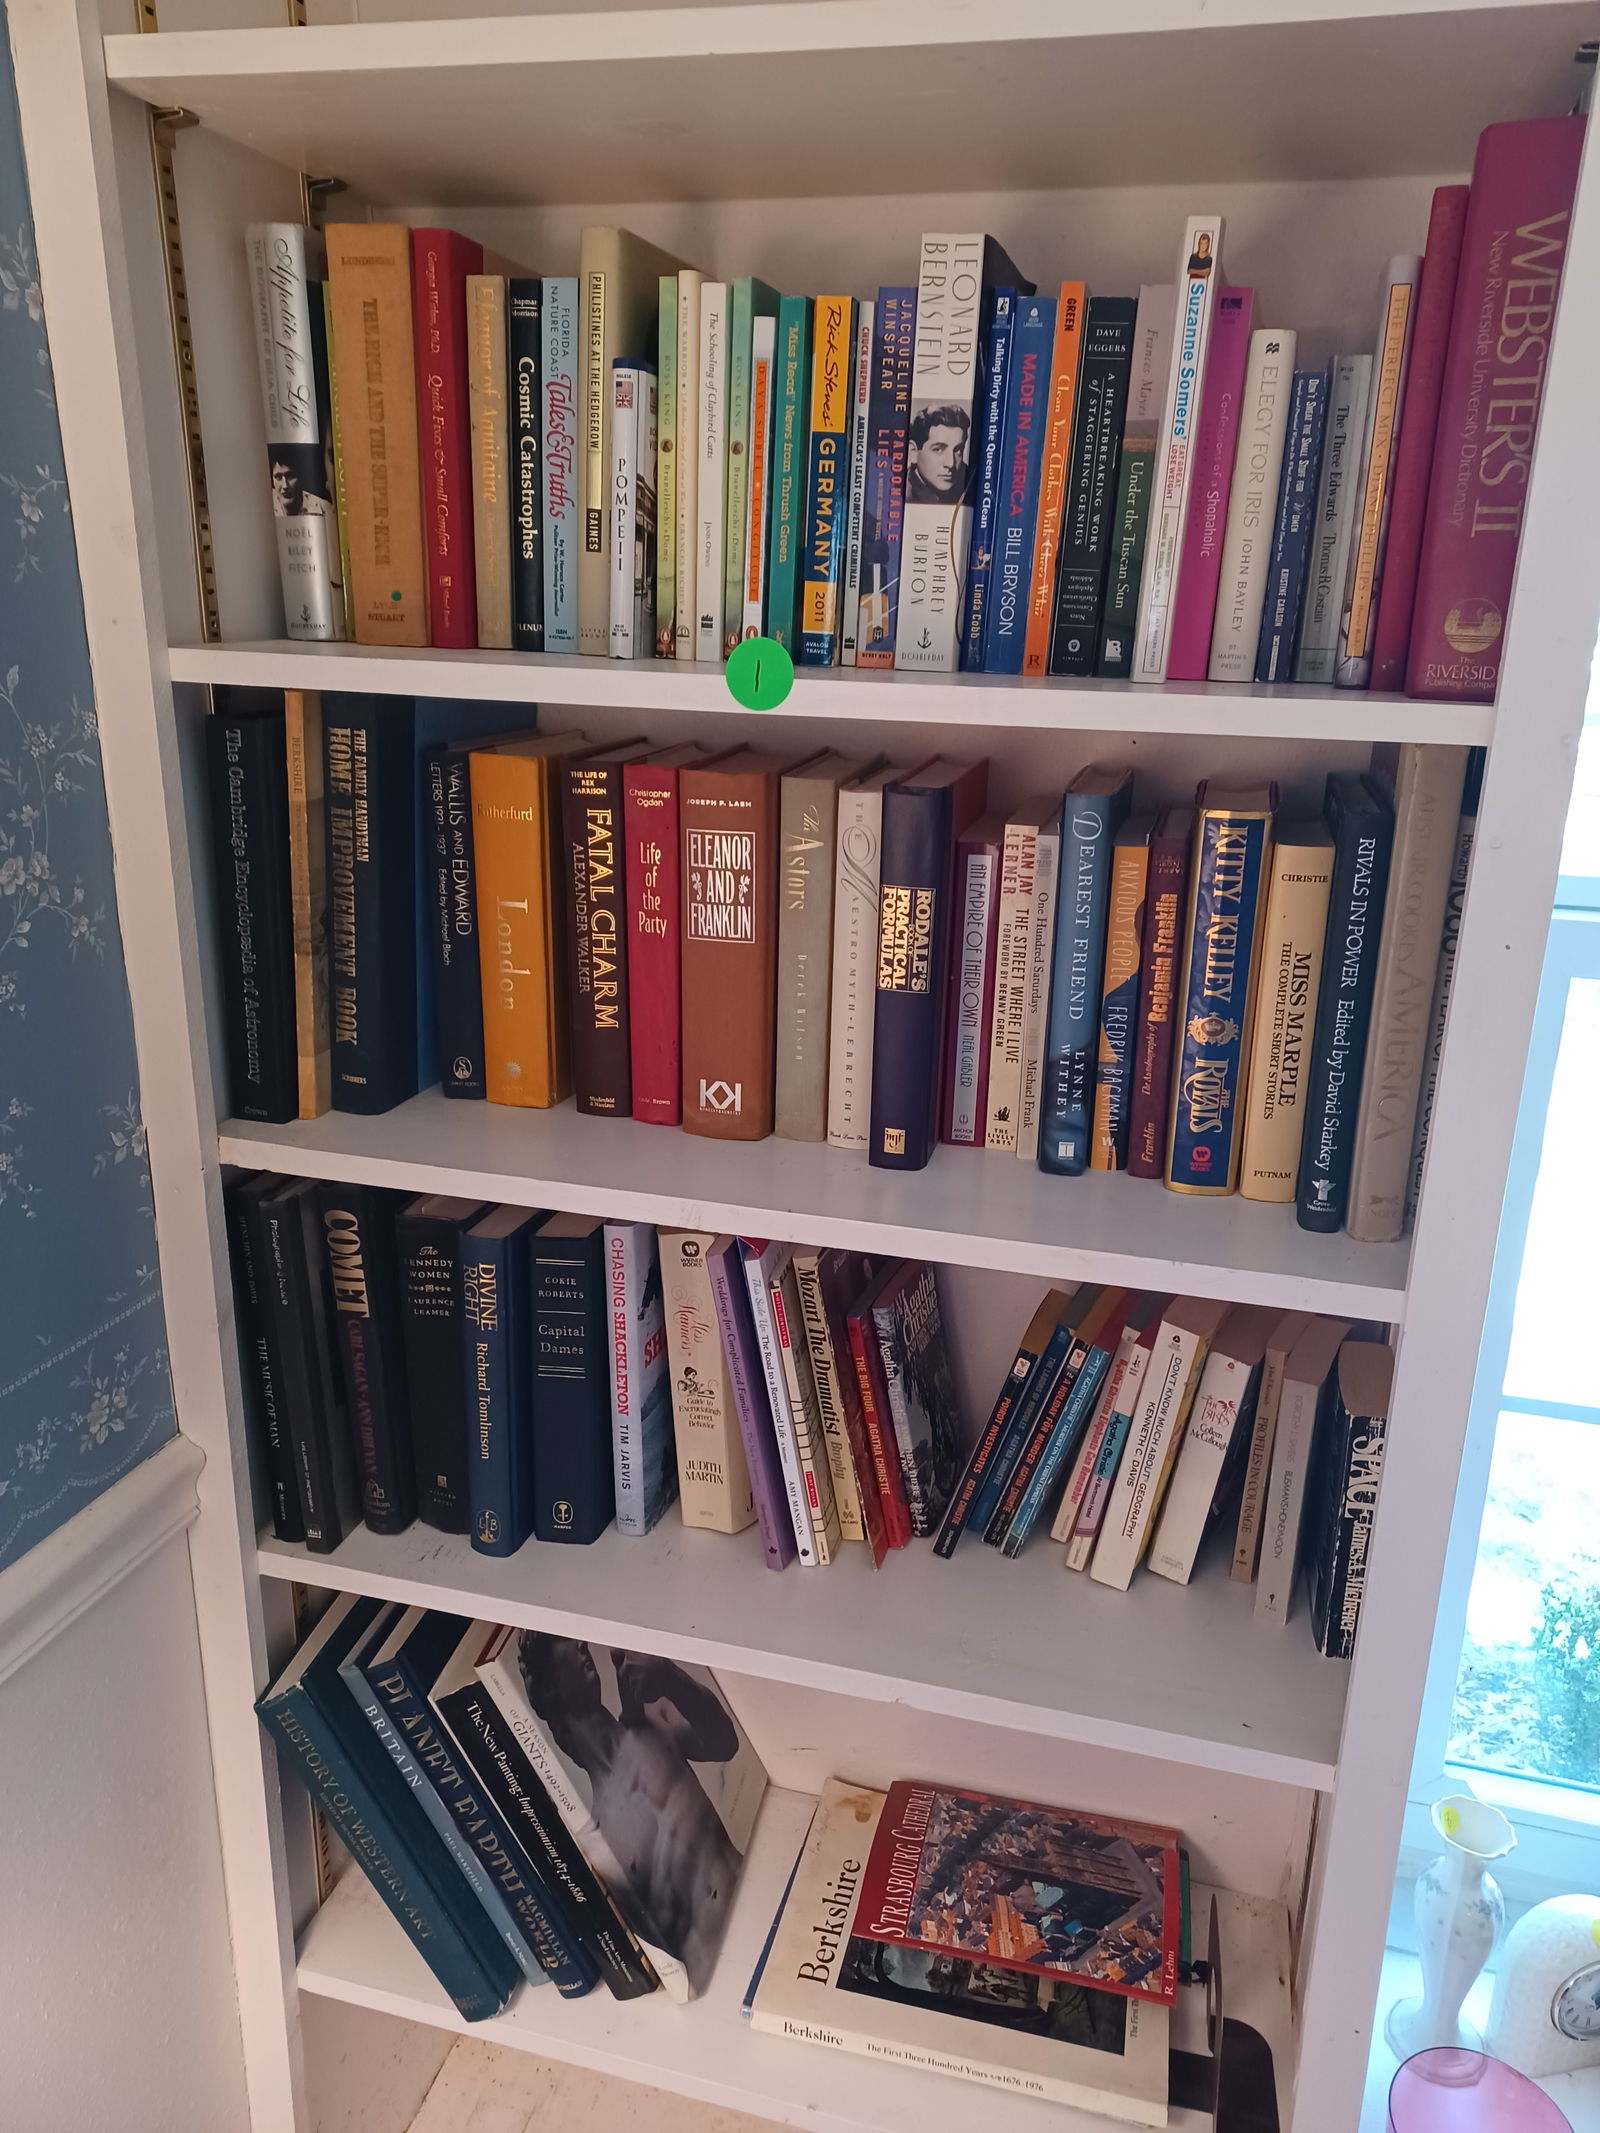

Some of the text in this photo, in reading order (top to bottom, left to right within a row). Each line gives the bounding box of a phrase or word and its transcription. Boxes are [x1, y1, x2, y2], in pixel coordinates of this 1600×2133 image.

[270, 238, 311, 431] Appetite for Life
[881, 299, 897, 390] WINSPEAR
[895, 299, 913, 412] JACQUELINE
[917, 242, 948, 375] BERNSTEIN
[947, 242, 980, 376] LEONARD
[1064, 298, 1077, 331] GREEN
[589, 276, 602, 449] PHILISTINES AT THE HEDGEROW
[822, 303, 843, 427] Rick Steves'
[1174, 283, 1206, 441] Suzanne Somers'
[1448, 230, 1510, 528] New Riverside University Dictionary
[1471, 211, 1570, 539] WEBSTER'S II
[518, 357, 539, 560] Cosmic Catastrophes
[876, 429, 890, 469] LIES
[887, 429, 904, 542] PARDONABLE
[1009, 354, 1038, 516] MADE IN AMERICA
[1074, 379, 1101, 546] of STAGGERING GENIUS
[1094, 388, 1114, 508] HEARTBREAKING
[1244, 366, 1277, 528] ELEGY FOR IRIS
[589, 512, 600, 550] GAINES
[615, 458, 630, 572] POMPEII
[814, 437, 836, 578] GERMANY
[1089, 514, 1100, 553] WORK
[1115, 461, 1145, 609] Under the Tuscan Sun
[813, 591, 826, 623] 2011
[910, 534, 930, 606] BURTON
[930, 525, 950, 615] HUMPHREY
[998, 527, 1022, 635] BILL BRYSON
[1231, 539, 1253, 633] JOHN BAYLEY
[354, 729, 370, 862] THE FAMILY HANDYMAN
[329, 726, 358, 1045] HOME IMPROVEMENT BOOK
[447, 762, 472, 935] WALLIS AND EDWARD
[640, 842, 663, 864] Life
[644, 866, 659, 887] of
[690, 834, 752, 871] ELEANOR
[706, 869, 735, 905] AND
[1003, 833, 1020, 895] LERNER
[1019, 834, 1036, 896] ALAN JAY
[573, 842, 590, 994] ALEXANDER WALKER
[586, 807, 619, 1028] FATAL CHARM
[638, 911, 668, 938] Party
[642, 893, 662, 910] the
[690, 902, 752, 939] FRANKLIN
[879, 886, 896, 989] FORMULAS
[892, 888, 912, 989] PRACTICAL
[912, 889, 933, 991] RODALE'S
[1015, 908, 1030, 931] THE
[1029, 891, 1049, 1013] One Hundred Saturdays
[1068, 811, 1104, 1020] DEAREST FRIEND
[1202, 824, 1248, 1002] KITTY KELLEY
[1341, 837, 1376, 988] RIVALS IN POWER
[494, 896, 531, 1010] London
[1010, 935, 1028, 980] STREET
[1005, 1037, 1020, 1063] LIVE
[1007, 985, 1025, 1026] WHERE
[1263, 942, 1293, 1120] THE COMPLETE SHORT STORIES
[1276, 952, 1313, 1107] MISS MARPLE
[1023, 1058, 1039, 1127] Michael Frank
[1056, 1043, 1072, 1118] WITHEY
[1071, 1050, 1086, 1111] LYNNE
[1183, 1057, 1231, 1133] ROYALS
[1317, 999, 1354, 1171] Edited by David Starkey
[325, 1209, 370, 1318] COMET
[464, 1265, 480, 1325] RIGHT
[478, 1262, 498, 1331] DIVINE
[538, 1290, 585, 1299] ROBERTS
[544, 1276, 577, 1285] COKIE
[538, 1324, 585, 1337] Capital
[540, 1342, 584, 1354] Dames
[611, 1237, 629, 1416] CHASING SHACKLETON
[797, 1266, 841, 1436] Mozart The Dramatist
[476, 1342, 492, 1459] Richard Tomlinson
[855, 1355, 875, 1413] THE BIG FOUR
[620, 1425, 632, 1490] TIM JARVIS
[829, 1441, 848, 1478] Brophy
[868, 1422, 891, 1495] AGATHA CHRISTIE
[1126, 1402, 1156, 1489] KENNETH C. DAVIS
[1344, 1435, 1387, 1520] SPACE
[364, 1706, 422, 1789] BRITAIN
[277, 1710, 432, 1940] HISTORY OF WESTERN ART
[468, 1702, 587, 1904] The New Painting: Impressionism 1874-1886
[868, 1788, 937, 1939] STRASBOURG CATHEDRAL
[797, 1857, 861, 1986] Berkshire
[784, 2020, 843, 2047] Berkshire
